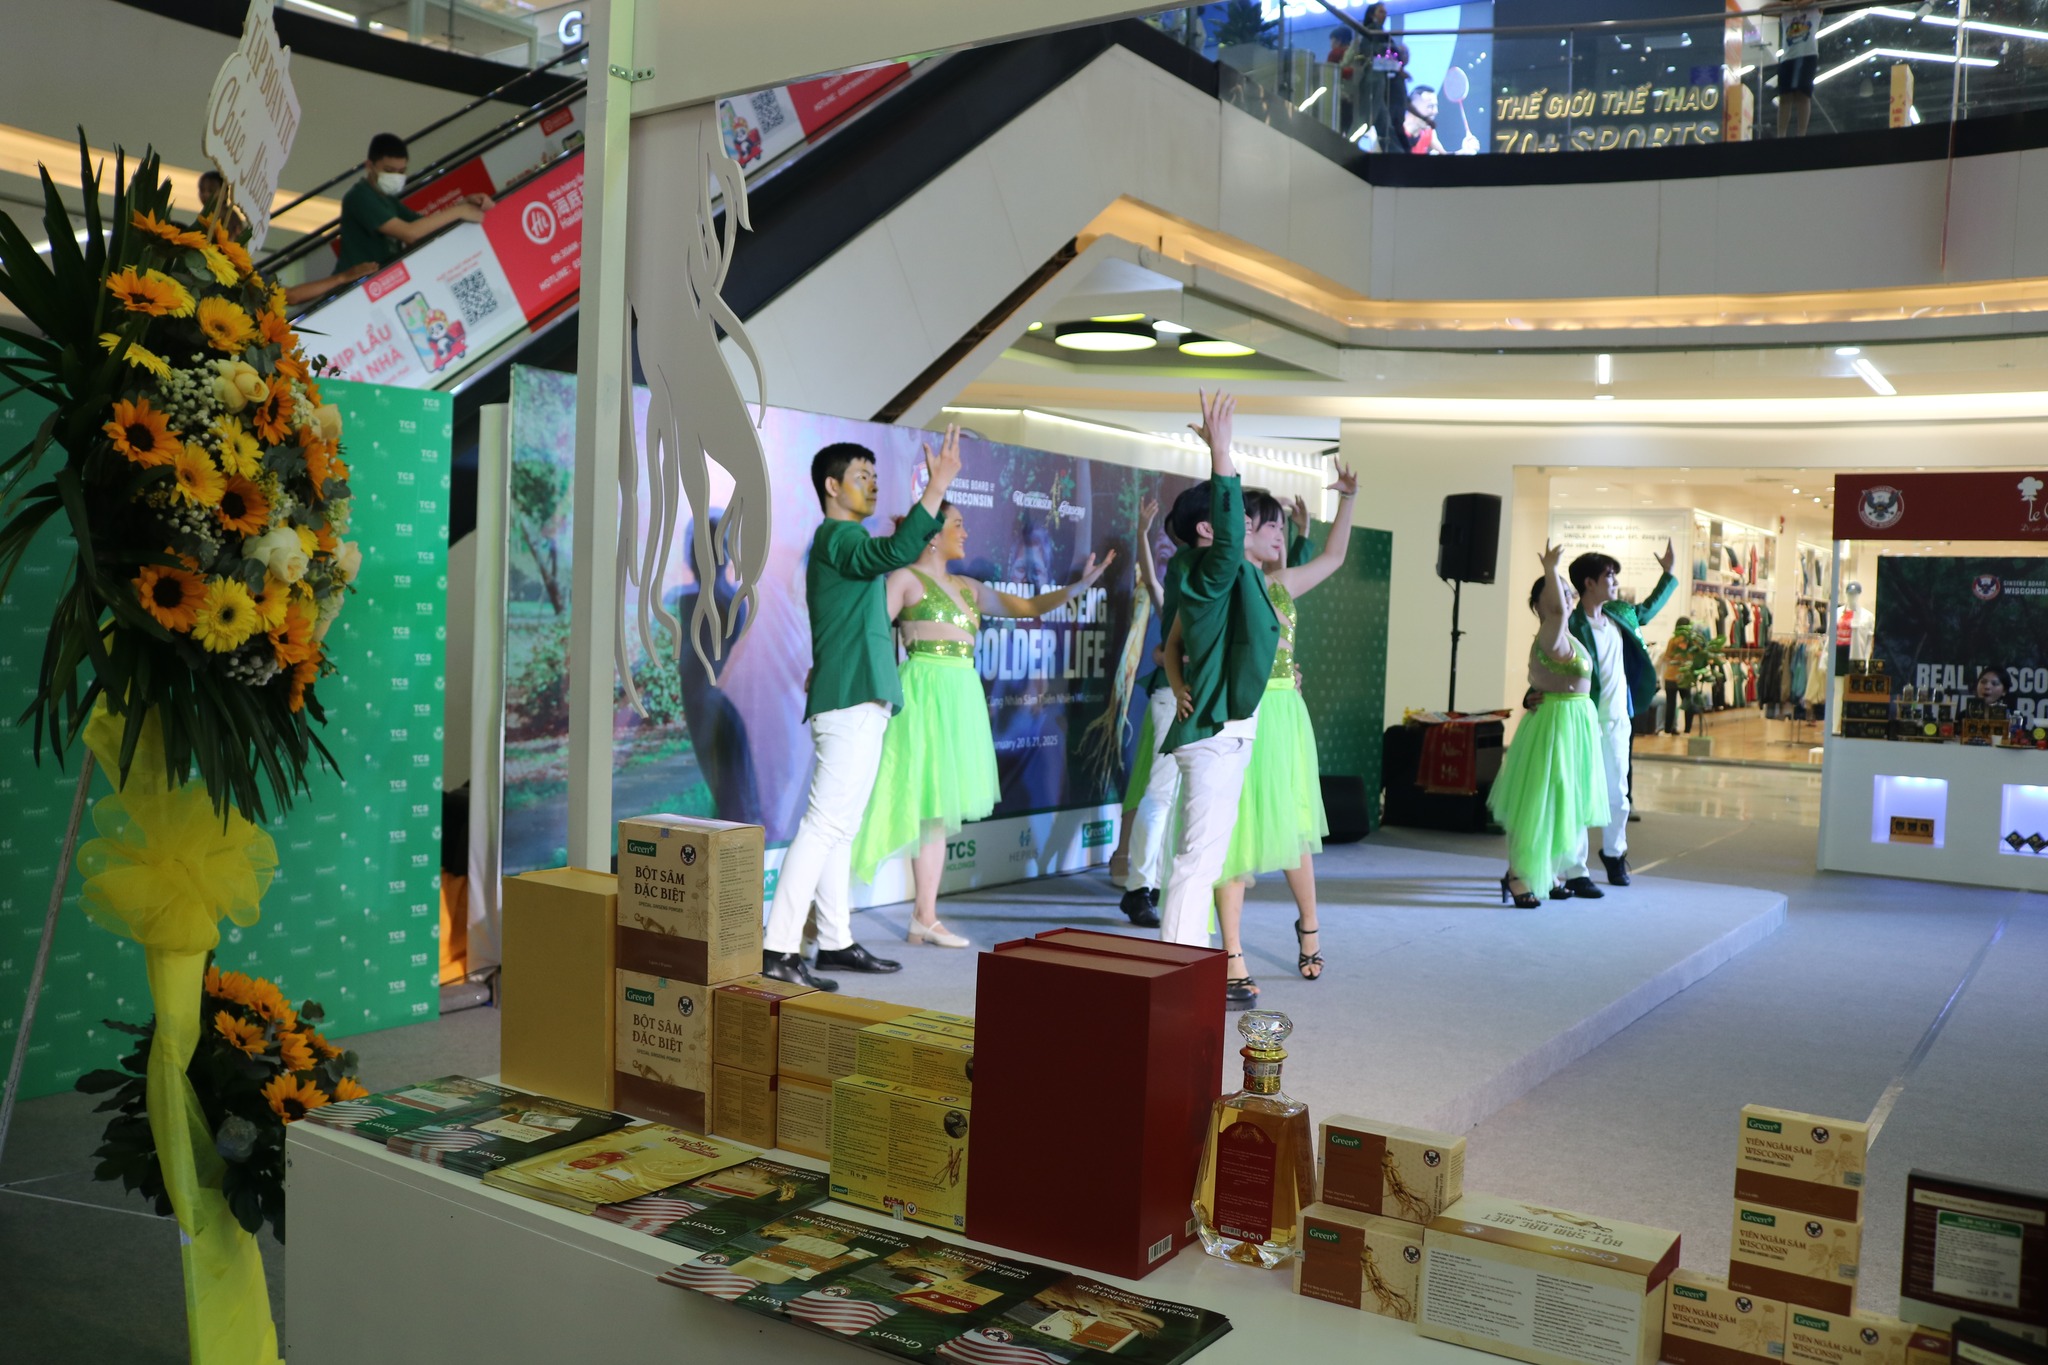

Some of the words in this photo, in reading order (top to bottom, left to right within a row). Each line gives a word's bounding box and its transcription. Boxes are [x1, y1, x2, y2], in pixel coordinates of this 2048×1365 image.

[558, 10, 583, 45] G
[1545, 88, 1597, 119] GIỚI
[1653, 85, 1719, 113] THAO
[1570, 121, 1720, 152] SPORTS
[945, 490, 994, 508] WISCONSIN
[1063, 630, 1106, 679] LIFE
[1916, 663, 1969, 690] REAL
[946, 839, 976, 860] TCS
[635, 865, 658, 882] BỘT
[660, 869, 685, 886] SÂM
[634, 883, 658, 899] ĐẶC
[660, 888, 686, 903] BIỆT
[633, 1013, 656, 1030] BỘT
[658, 1019, 683, 1037] SÂM
[632, 1030, 656, 1047] ĐẶC
[658, 1037, 683, 1053] BIỆT
[1745, 1147, 1794, 1162] WISCONSIN
[1739, 1238, 1788, 1255] WISCONSIN
[1671, 1312, 1720, 1330] WISCONSIN
[1792, 1342, 1843, 1360] WISCONSIN
